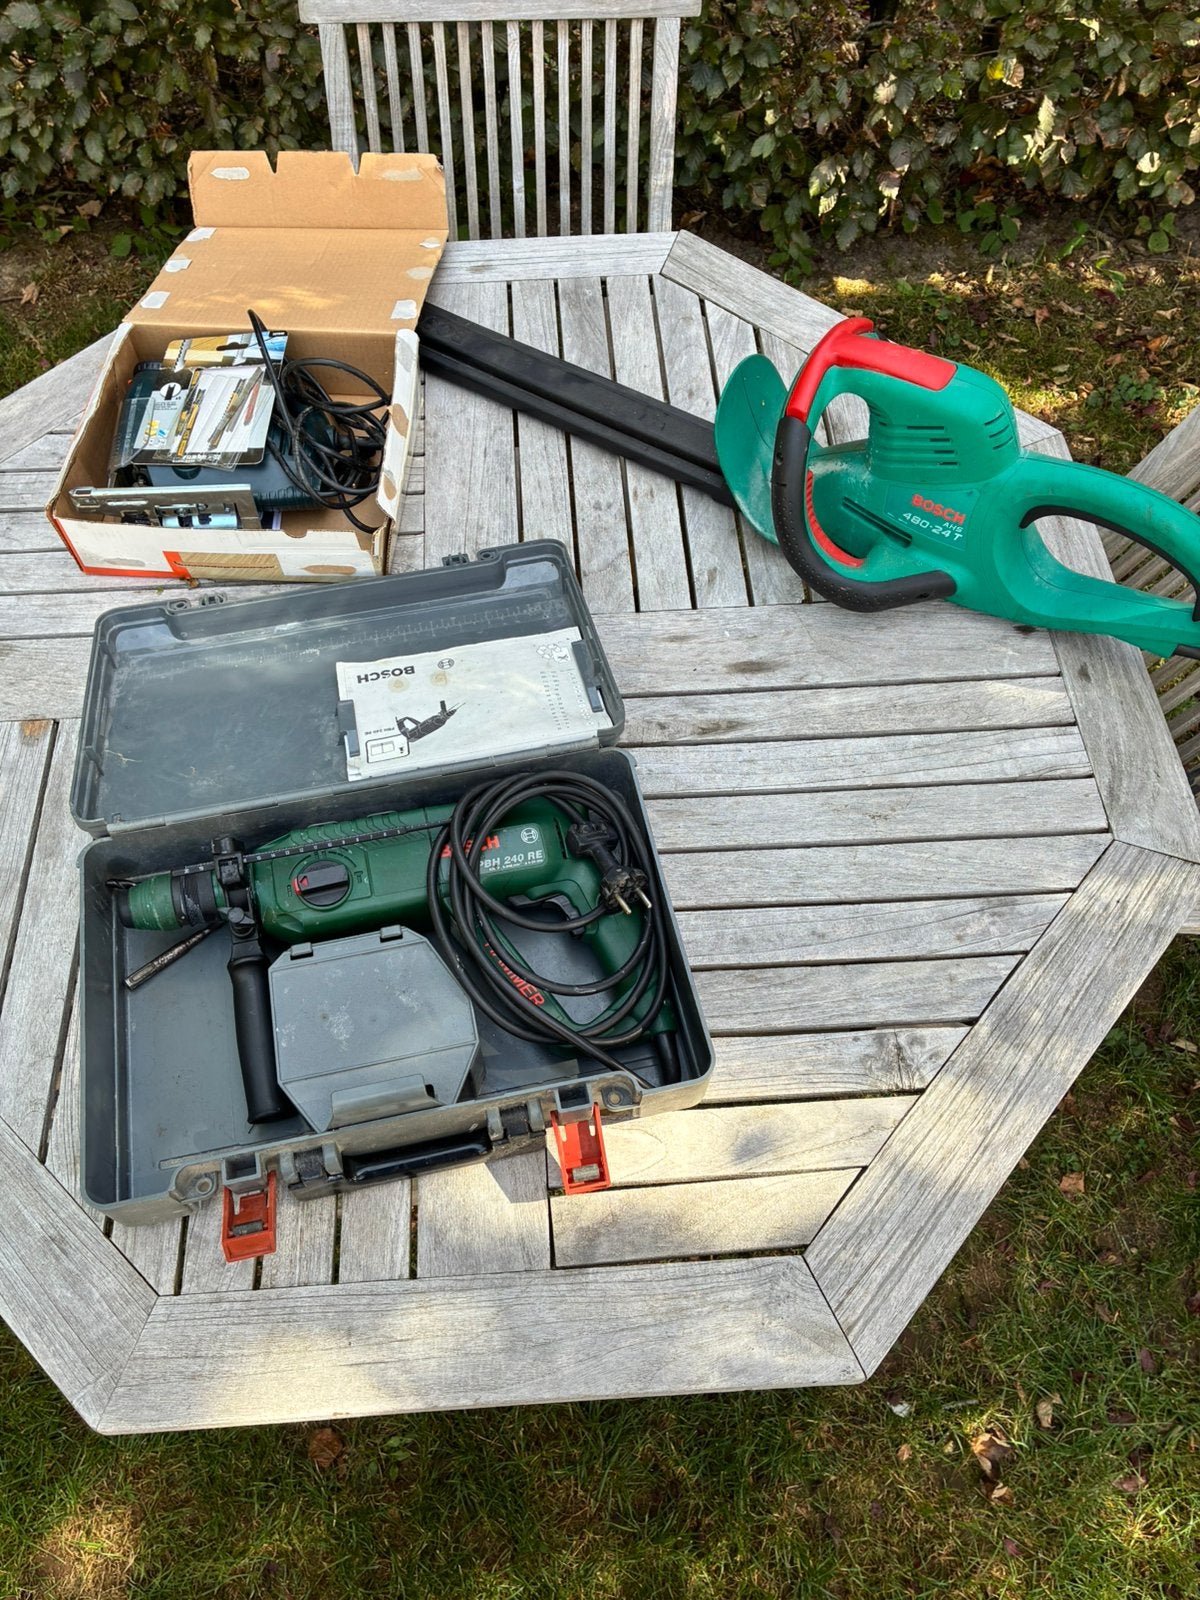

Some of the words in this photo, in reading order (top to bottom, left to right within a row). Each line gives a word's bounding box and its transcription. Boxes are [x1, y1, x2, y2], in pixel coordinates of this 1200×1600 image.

[911, 493, 966, 526] BOSCH
[942, 522, 964, 533] AHS
[357, 665, 416, 684] BOSCH
[503, 852, 524, 865] 240
[527, 849, 544, 860] RE
